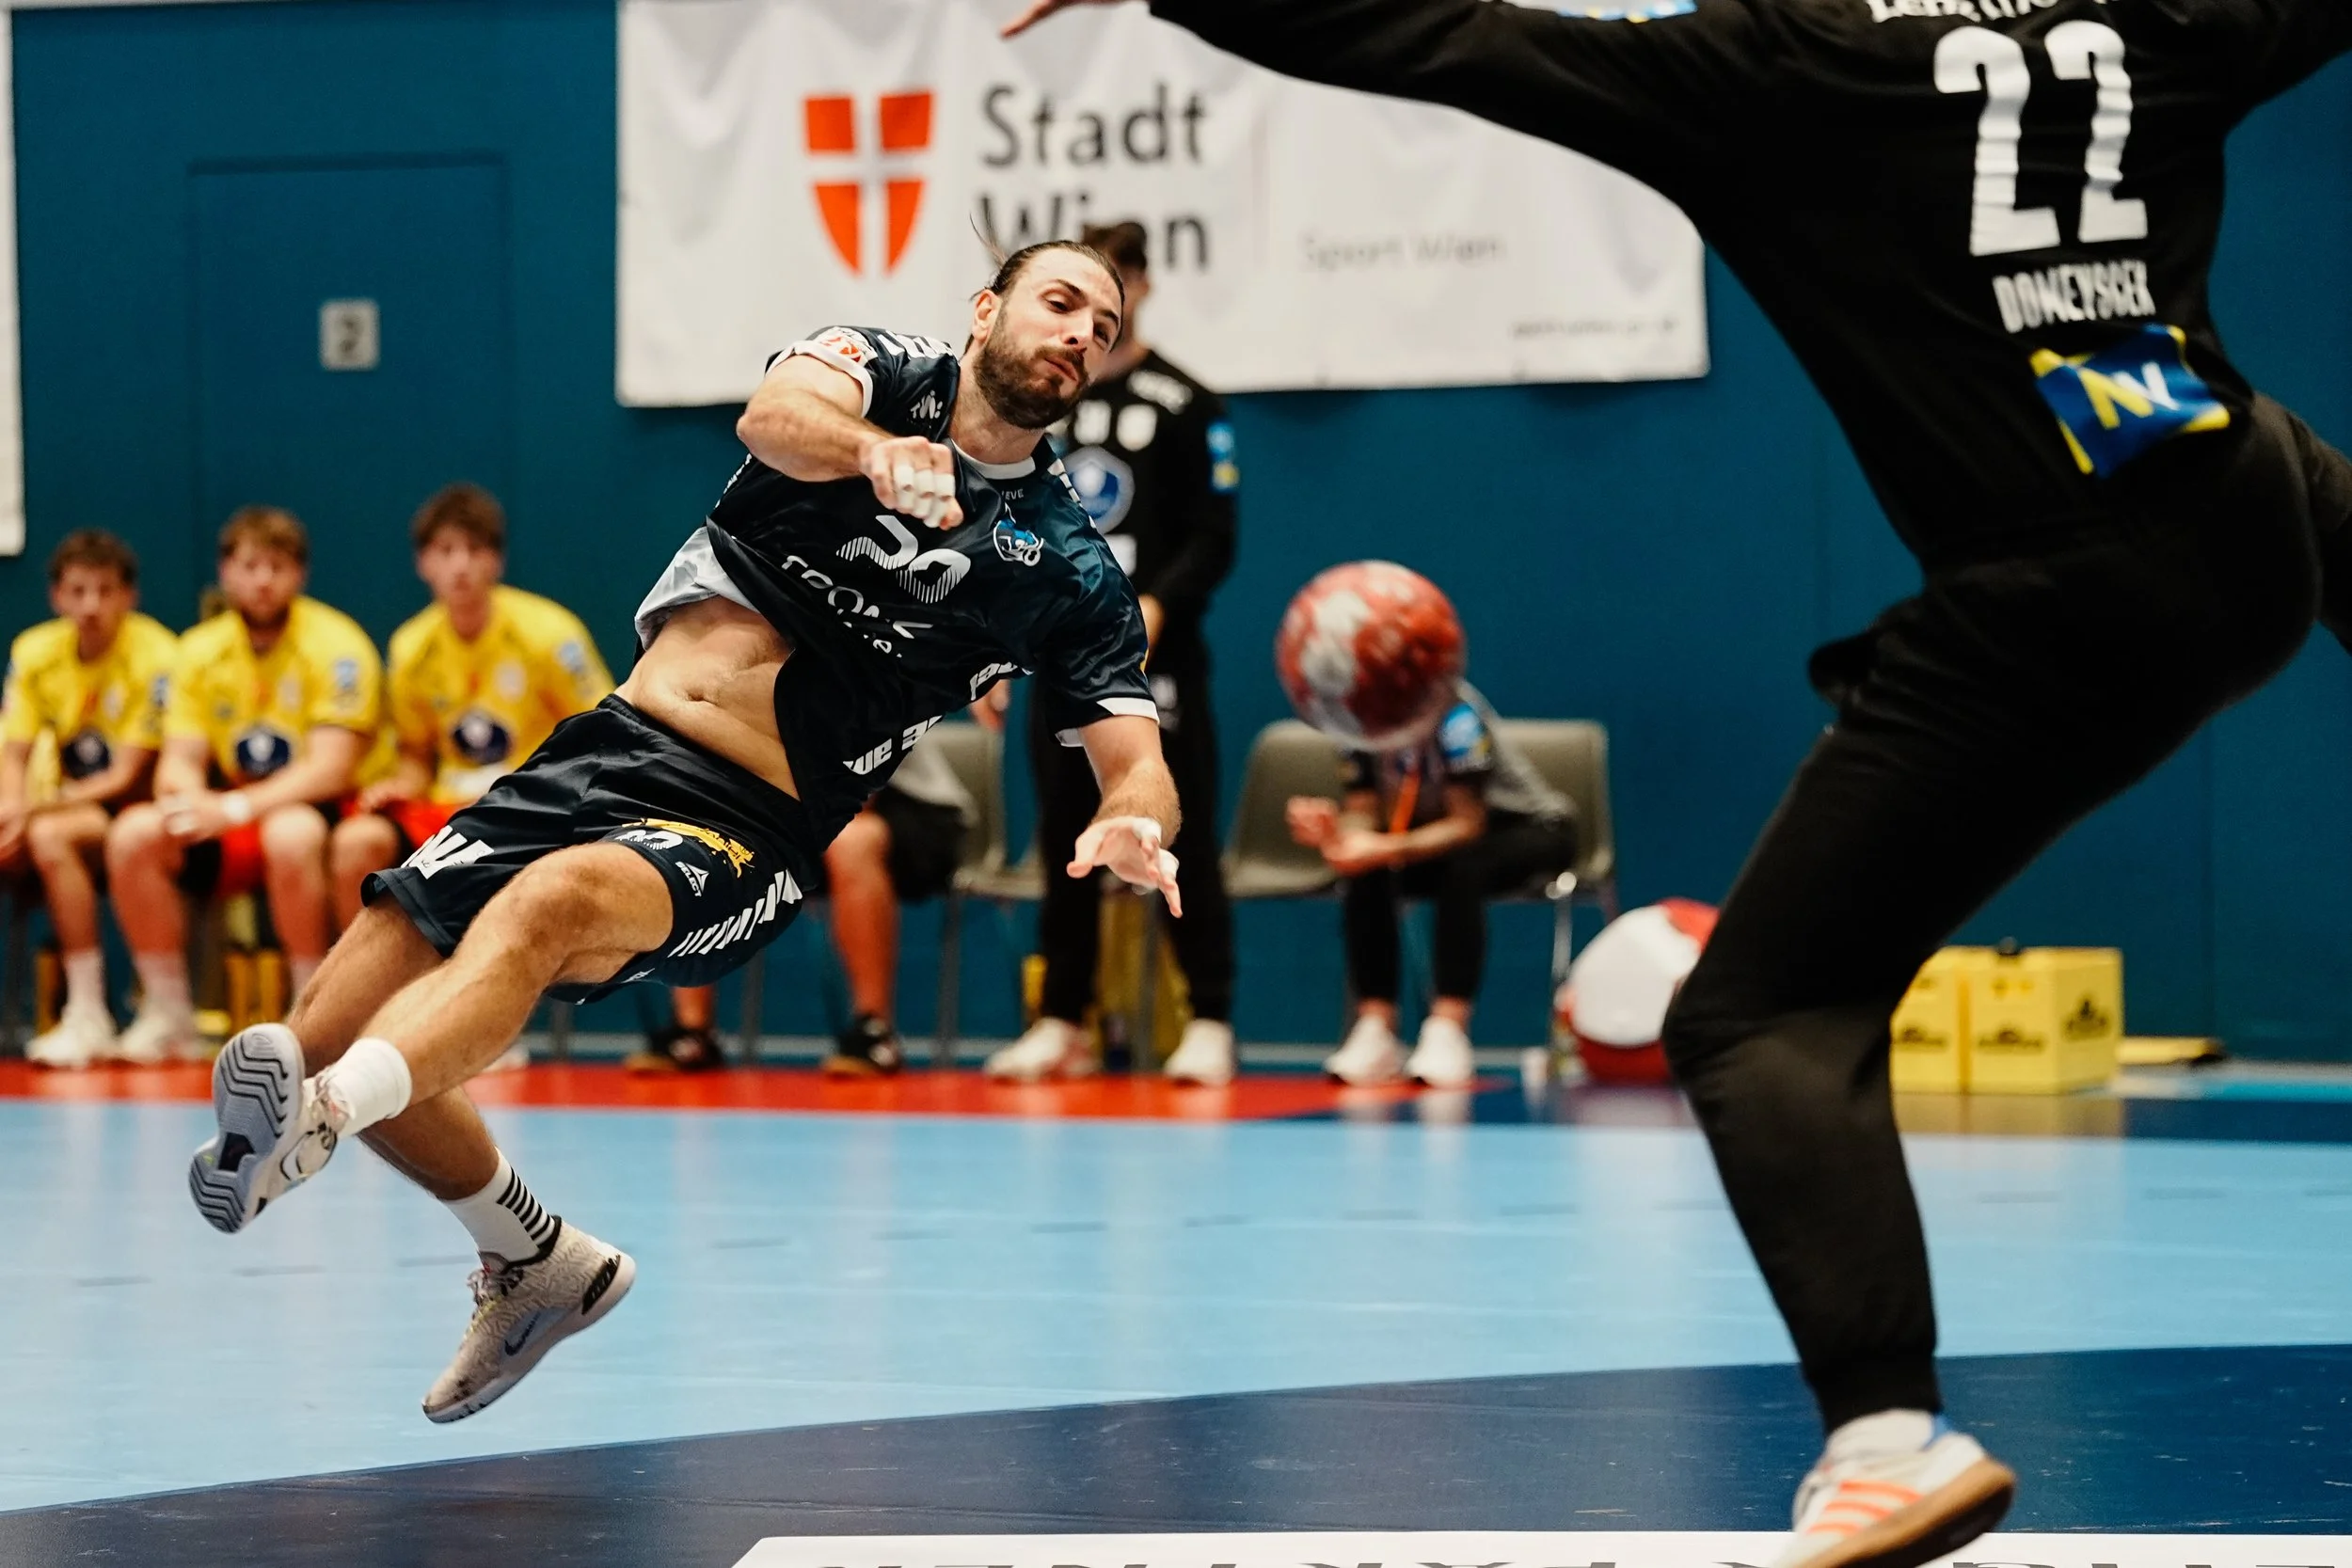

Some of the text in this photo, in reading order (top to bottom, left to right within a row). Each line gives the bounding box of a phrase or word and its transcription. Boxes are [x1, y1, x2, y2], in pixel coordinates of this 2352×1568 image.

[980, 79, 1208, 167] Stadt
[1933, 19, 2149, 256] 22
[675, 861, 702, 898] SELECT
